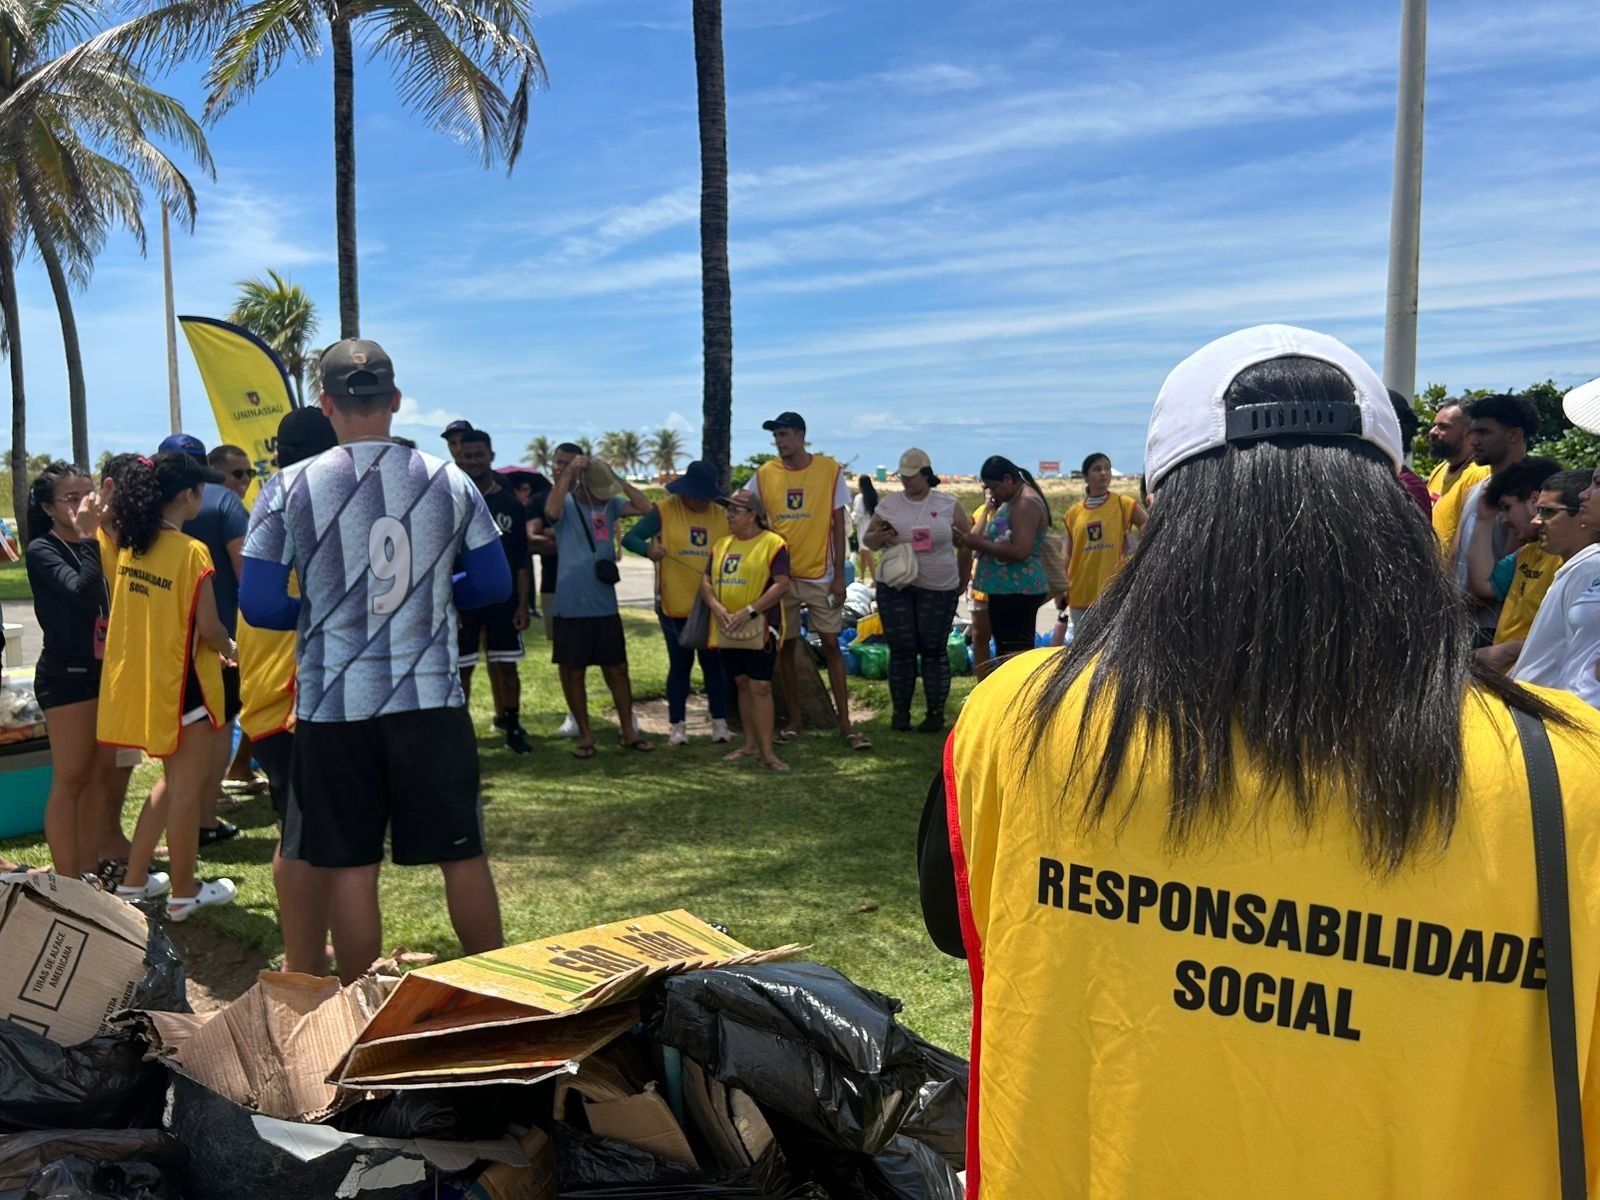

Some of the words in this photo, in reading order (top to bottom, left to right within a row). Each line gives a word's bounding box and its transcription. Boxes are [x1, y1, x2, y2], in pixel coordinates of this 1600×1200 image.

[368, 515, 413, 616] 9
[49, 931, 66, 959] ALFACE
[1037, 857, 1547, 990] RESPONSABILIDADE
[31, 969, 50, 992] TIRAS
[43, 957, 56, 970] DE
[48, 945, 73, 988] AMERICANA
[1173, 959, 1362, 1041] SOCIAL
